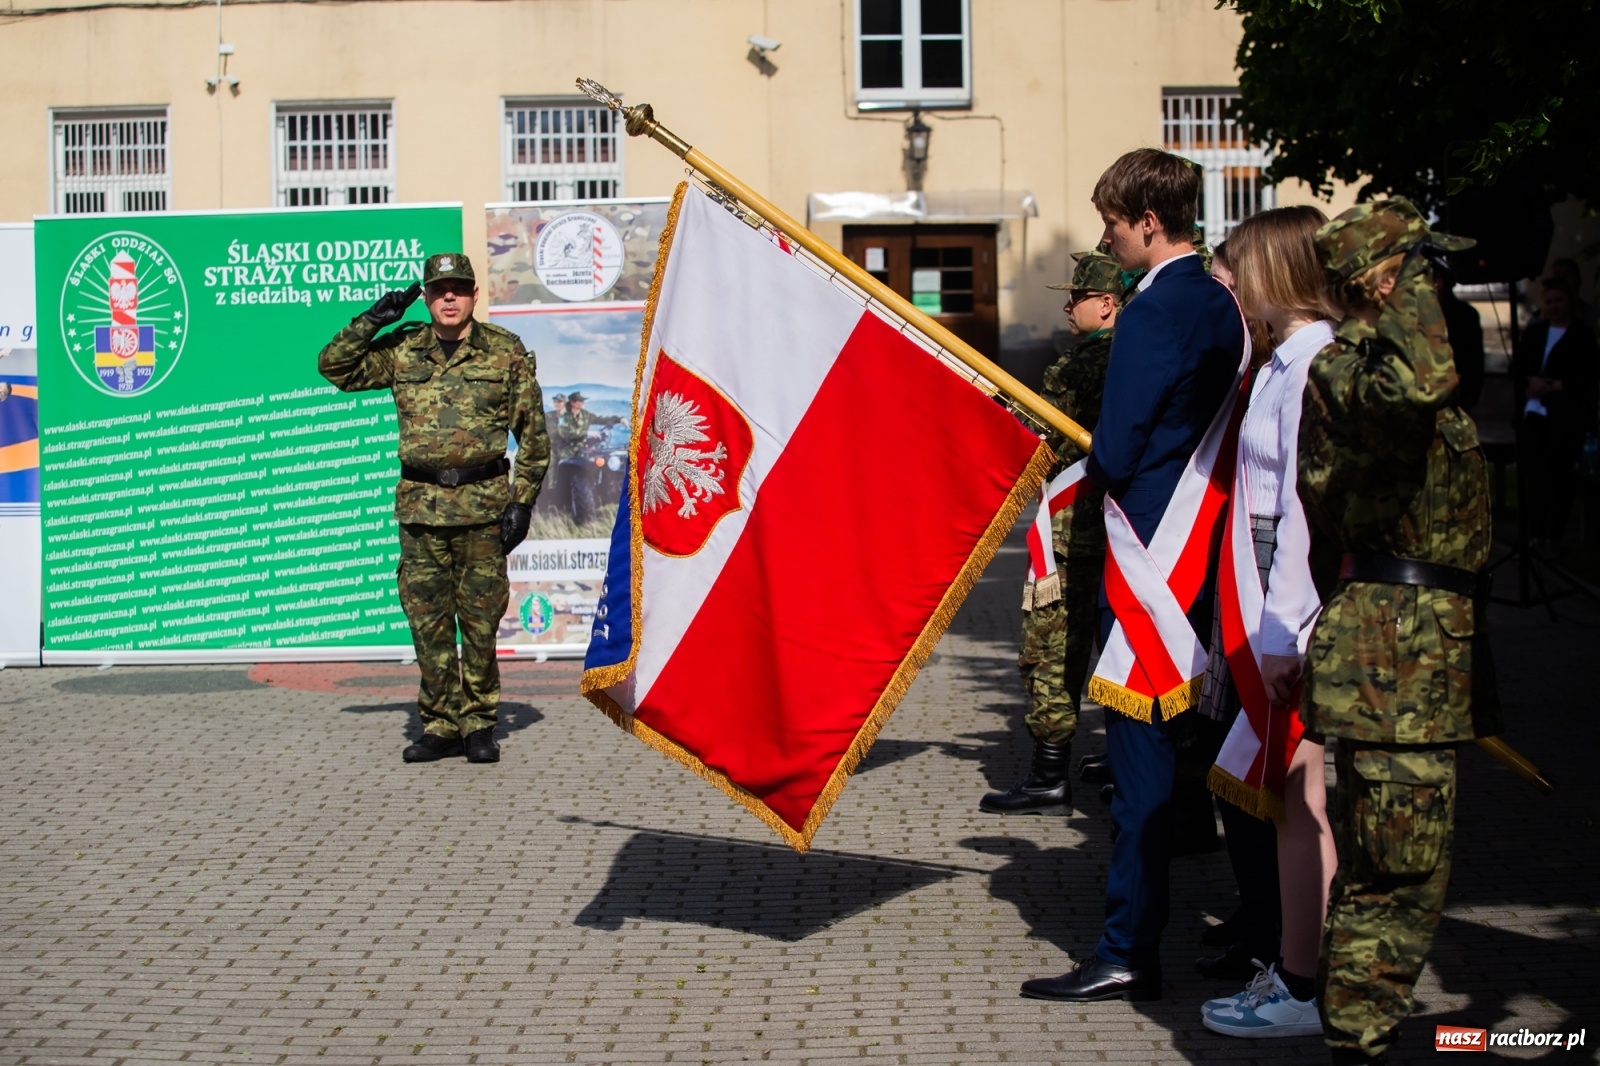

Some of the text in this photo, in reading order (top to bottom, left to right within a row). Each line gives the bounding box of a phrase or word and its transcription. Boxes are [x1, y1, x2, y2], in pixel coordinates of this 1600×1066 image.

[69, 237, 177, 287] ŚLĄSKI ODDZIAŁ SG
[227, 238, 425, 266] ŚLĄSKI ODDZIAŁ
[204, 260, 425, 287] STRAŻY GRANICZN
[215, 291, 226, 305] z
[230, 286, 312, 307] siedzibą
[316, 289, 334, 302] w
[99, 367, 152, 378] 1919 1921
[44, 411, 151, 435] www.slaski.strazgraniczna.pl
[156, 394, 264, 418] www.slaski.strazgraniczna.pl
[269, 385, 340, 402] www.slaski.strazg
[136, 416, 243, 440] www.slaski.strazgraniczna.pl
[248, 399, 357, 423] www.slaski.strazgraniczna.pl
[45, 448, 152, 472] www.slaski.strazgraniczna.pl
[157, 431, 265, 455] www.slaski.strazgraniczna.pl
[270, 414, 379, 438] www.slaski.strazgraniczna.pl
[138, 453, 246, 477] www.slaski.strazgraniczna.pl
[251, 436, 359, 460] www.slaski.strazgraniczna.pl
[47, 484, 154, 508] www.slaski.strazgraniczna.pl
[159, 468, 267, 492] www.slaski.strazgraniczna.pl
[272, 451, 381, 475] www.slaski.strazgraniczna.pl
[138, 490, 246, 514] www.slaski.strazgraniczna.pl
[251, 473, 359, 497] www.slaski.strazgraniczna.pl
[48, 519, 155, 543] www.slaski.strazgraniczna.pl
[160, 502, 268, 526] www.slaski.strazgraniczna.pl
[273, 486, 382, 510] www.slaski.strazgraniczna.pl
[140, 523, 248, 547] www.slaski.strazgraniczna.pl
[253, 507, 361, 531] www.slaski.strazgraniczna.pl
[50, 551, 157, 575] www.slaski.strazgraniczna.pl
[162, 535, 270, 559] www.slaski.strazgraniczna.pl
[275, 519, 384, 543] www.slaski.strazgraniczna.pl
[140, 555, 248, 579] www.slaski.strazgraniczna.pl
[252, 539, 361, 563] www.slaski.strazgraniczna.pl
[508, 549, 608, 571] ww.slaski.strazg
[50, 586, 157, 610] www.slaski.strazgraniczna.pl
[162, 570, 270, 594] www.slaski.strazgraniczna.pl
[275, 554, 384, 578] www.slaski.strazgraniczna.pl
[142, 590, 250, 614] www.slaski.strazgraniczna.pl
[255, 574, 363, 598] www.slaski.strazgraniczna.pl
[50, 620, 157, 644] www.slaski.strazgraniczna.pl
[162, 604, 270, 628] www.slaski.strazgraniczna.pl
[275, 587, 384, 611] www.slaski.strazgraniczna.pl
[138, 625, 246, 649] www.slaski.strazgraniczna.pl
[251, 609, 360, 633] www.slaski.strazgraniczna.pl
[276, 622, 385, 646] www.slaski.strazgraniczna.pl
